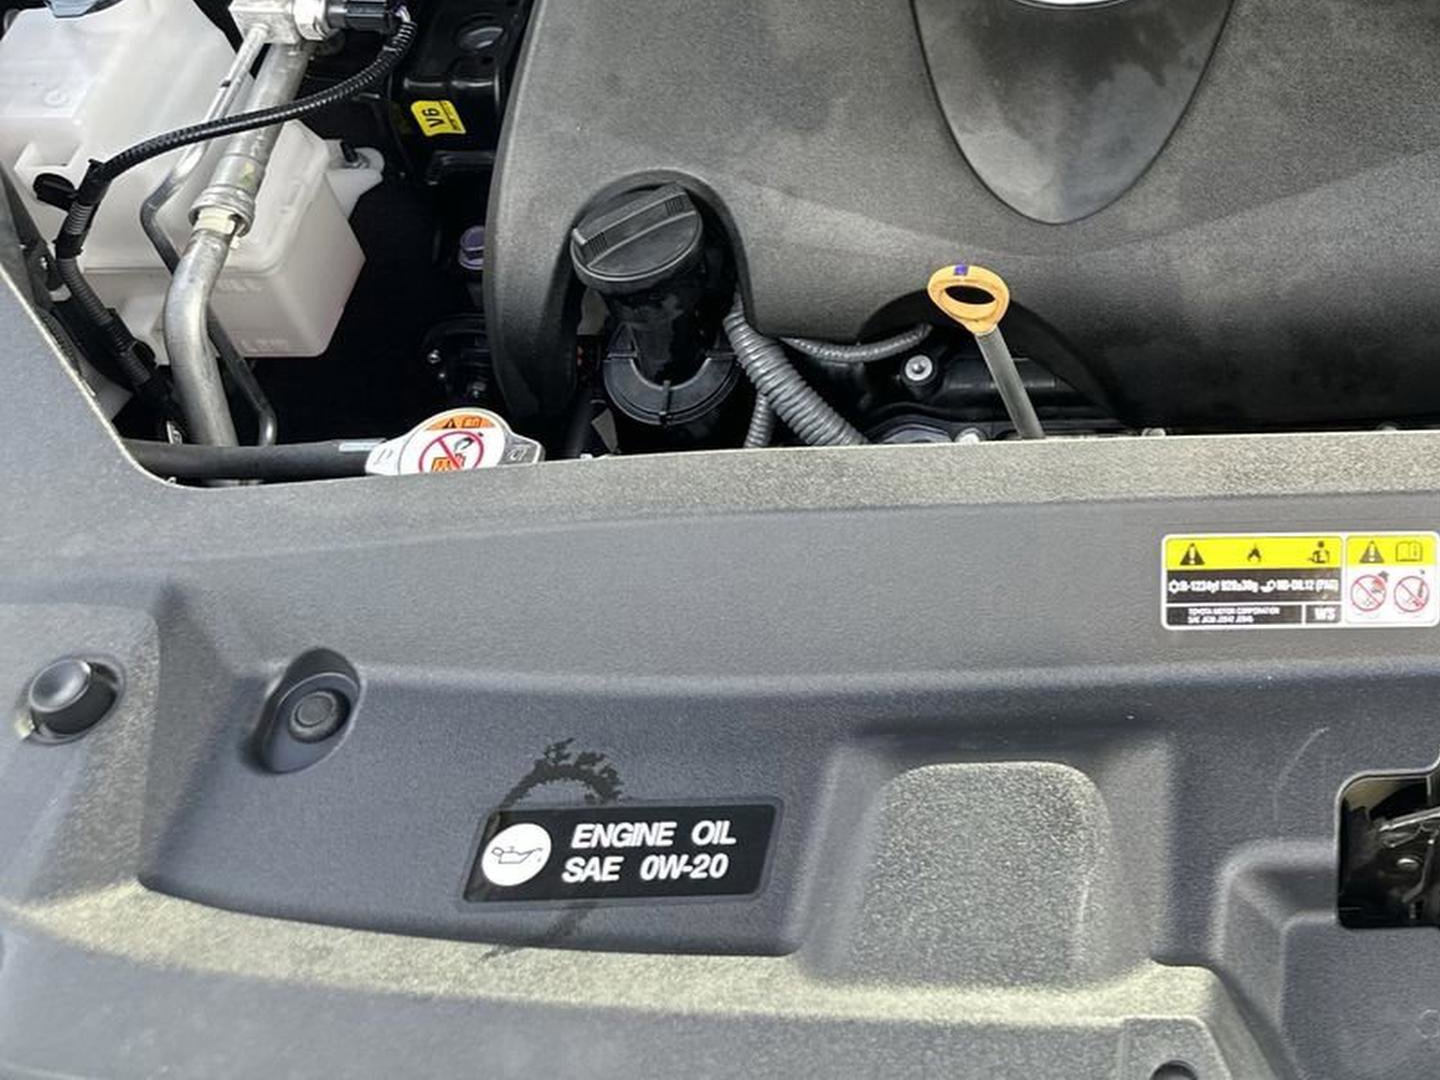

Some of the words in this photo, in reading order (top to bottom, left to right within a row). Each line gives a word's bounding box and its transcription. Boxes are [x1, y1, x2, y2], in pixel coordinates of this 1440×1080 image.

[421, 107, 445, 128] V6
[570, 821, 678, 849] ENGINE
[690, 819, 738, 846] OIL
[560, 855, 625, 884] SAE
[639, 853, 730, 881] 0W-20
